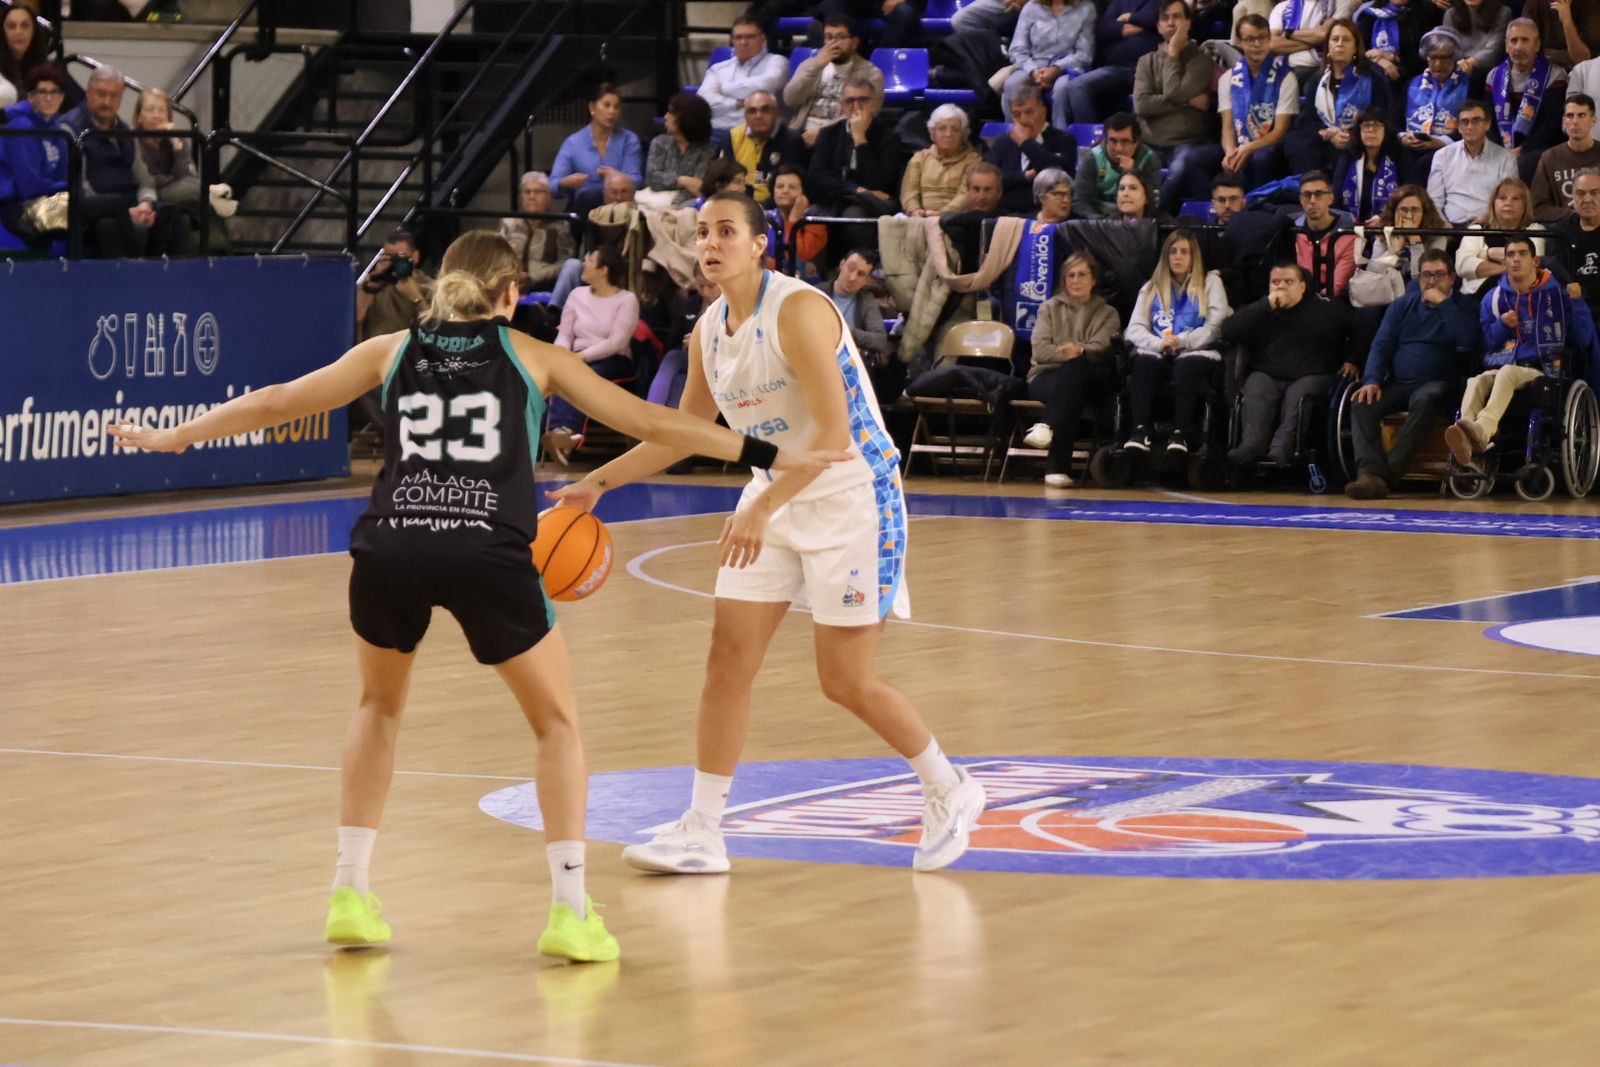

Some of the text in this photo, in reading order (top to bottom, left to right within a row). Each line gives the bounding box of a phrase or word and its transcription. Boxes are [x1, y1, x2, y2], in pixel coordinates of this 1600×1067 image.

[398, 391, 501, 462] 23
[401, 468, 492, 490] MÁLAGA
[392, 485, 499, 511] COMPITE
[394, 503, 405, 511] LA
[406, 503, 447, 512] PROVINCIA
[461, 507, 489, 517] FORMA
